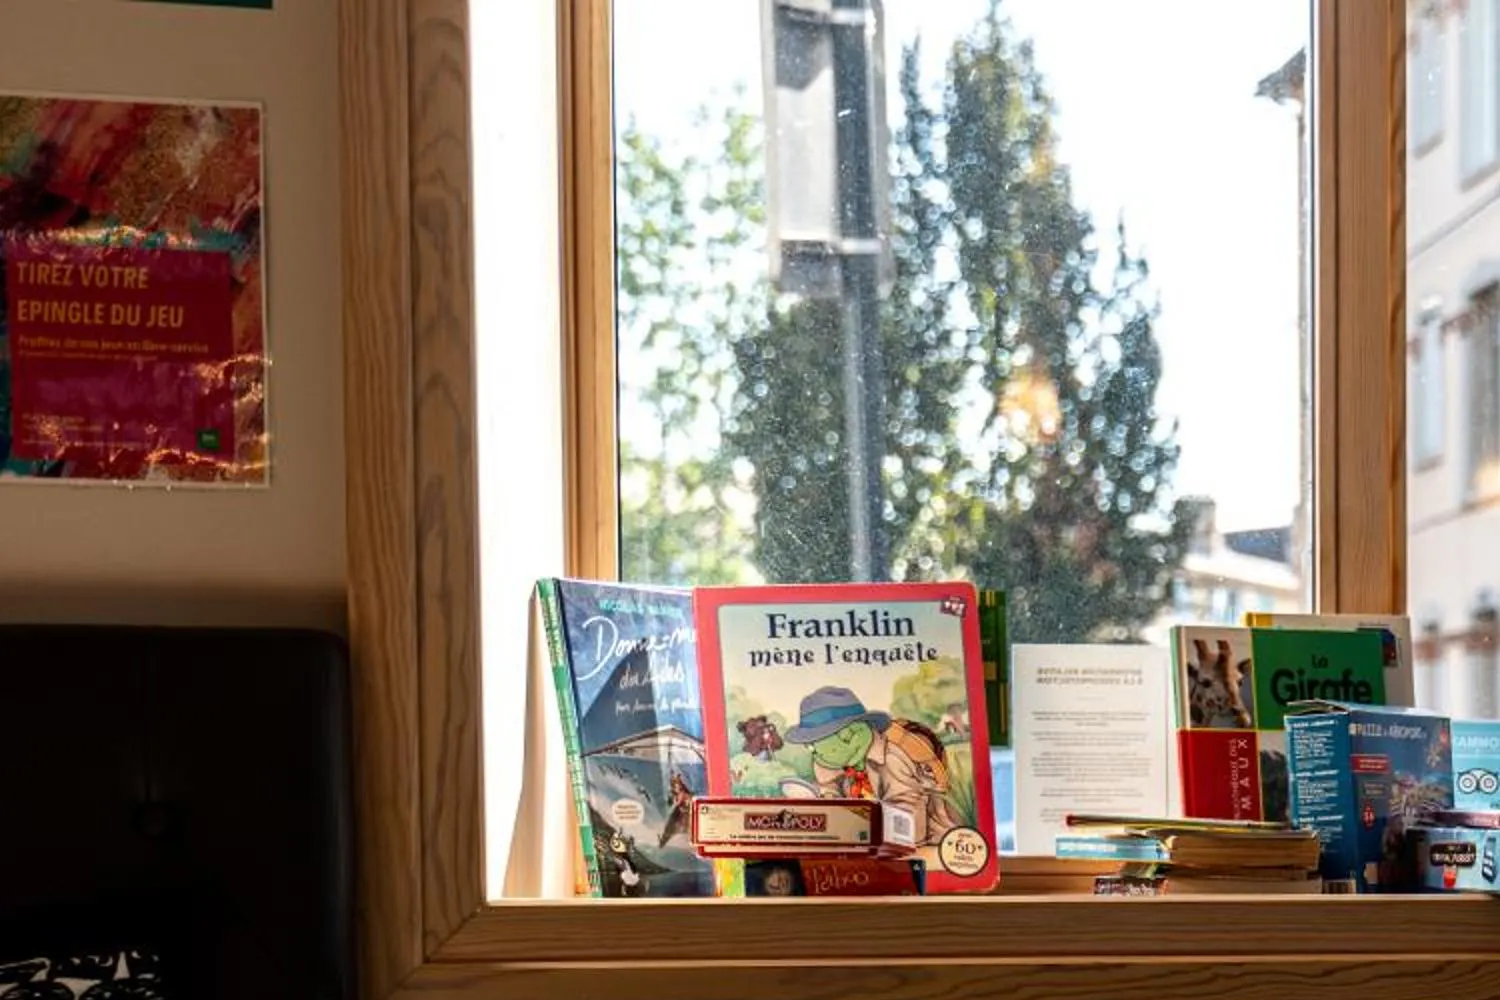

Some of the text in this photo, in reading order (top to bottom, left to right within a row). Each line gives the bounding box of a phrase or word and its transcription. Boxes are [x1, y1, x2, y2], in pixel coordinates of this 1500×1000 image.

[16, 261, 149, 289] TIREZ VOTRE
[17, 299, 184, 328] EPINGLE DU JEU
[766, 609, 916, 638] Franklin
[576, 615, 696, 681] Donne-m
[749, 641, 940, 667] mène l'enquête
[1311, 654, 1328, 668] La
[1271, 668, 1372, 707] Girafe
[1237, 738, 1252, 811] MAUX
[955, 840, 976, 854] 60
